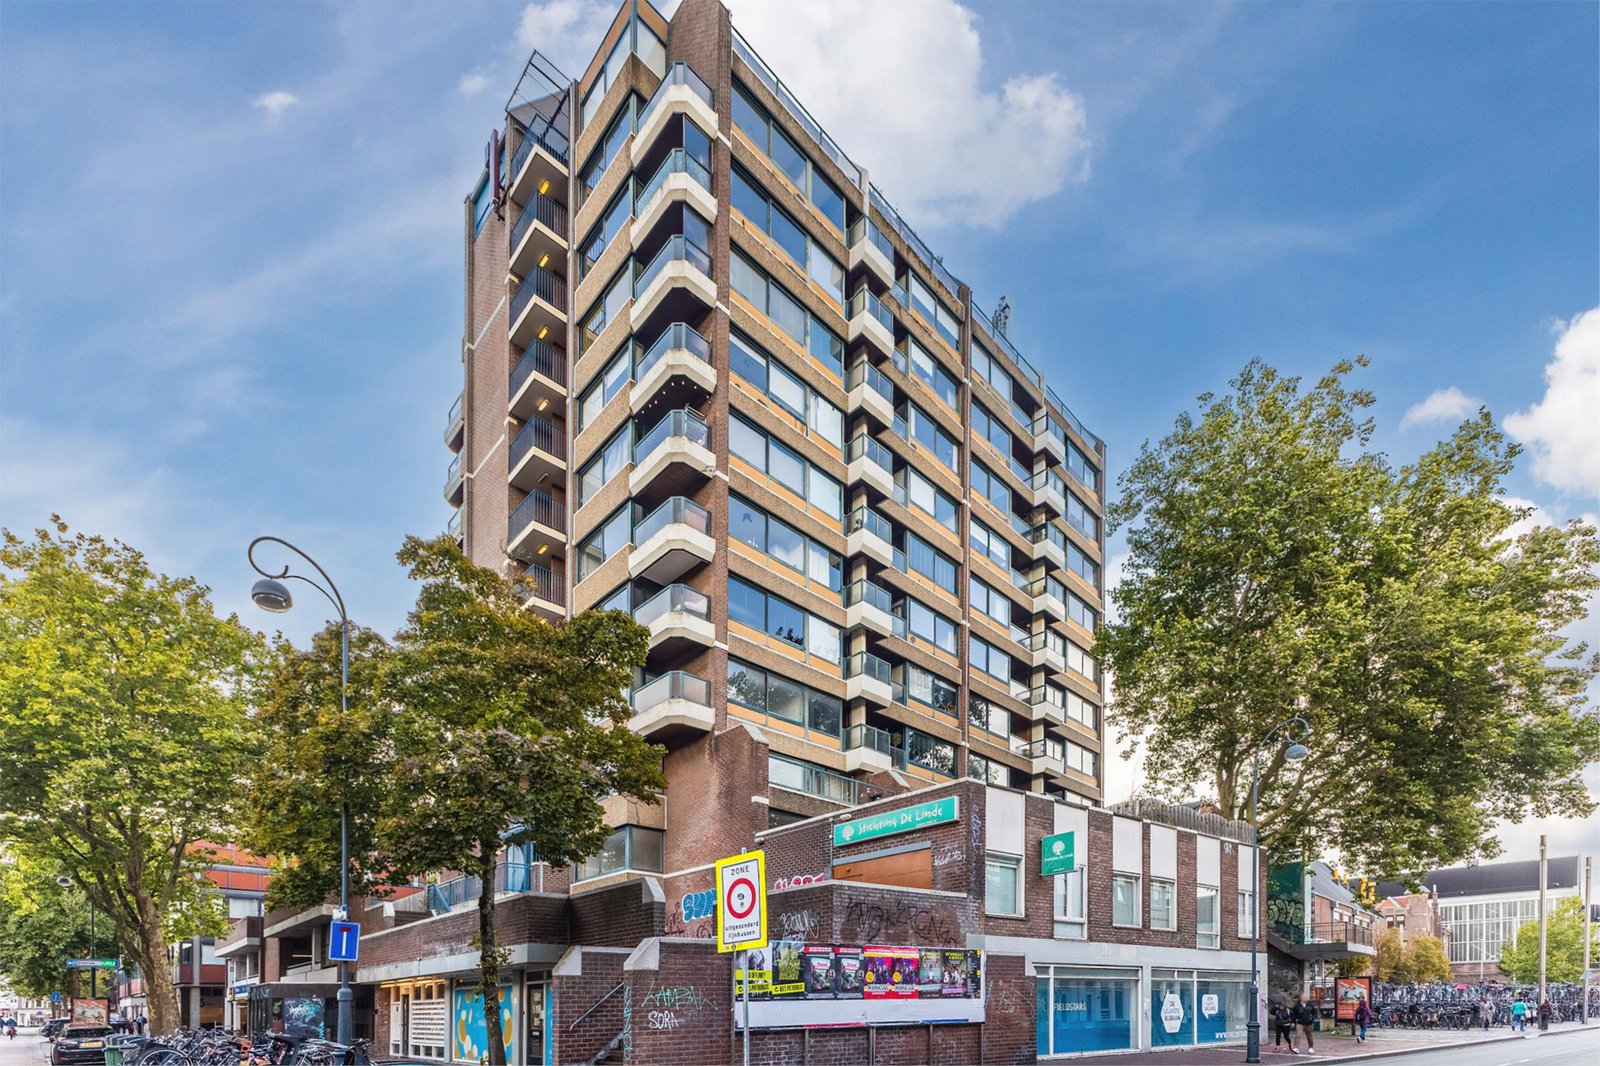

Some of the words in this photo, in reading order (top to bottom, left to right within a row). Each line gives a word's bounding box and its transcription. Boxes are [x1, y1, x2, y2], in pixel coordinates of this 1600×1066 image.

[858, 818, 897, 835] Stichting
[900, 812, 912, 824] De
[916, 803, 943, 820] Linde
[730, 865, 750, 876] ZONE
[725, 920, 759, 932] uitgezonderd
[728, 930, 756, 939] lijnbussen
[1054, 1002, 1087, 1011] FIELDSTARS
[648, 1010, 679, 1030] SORA
